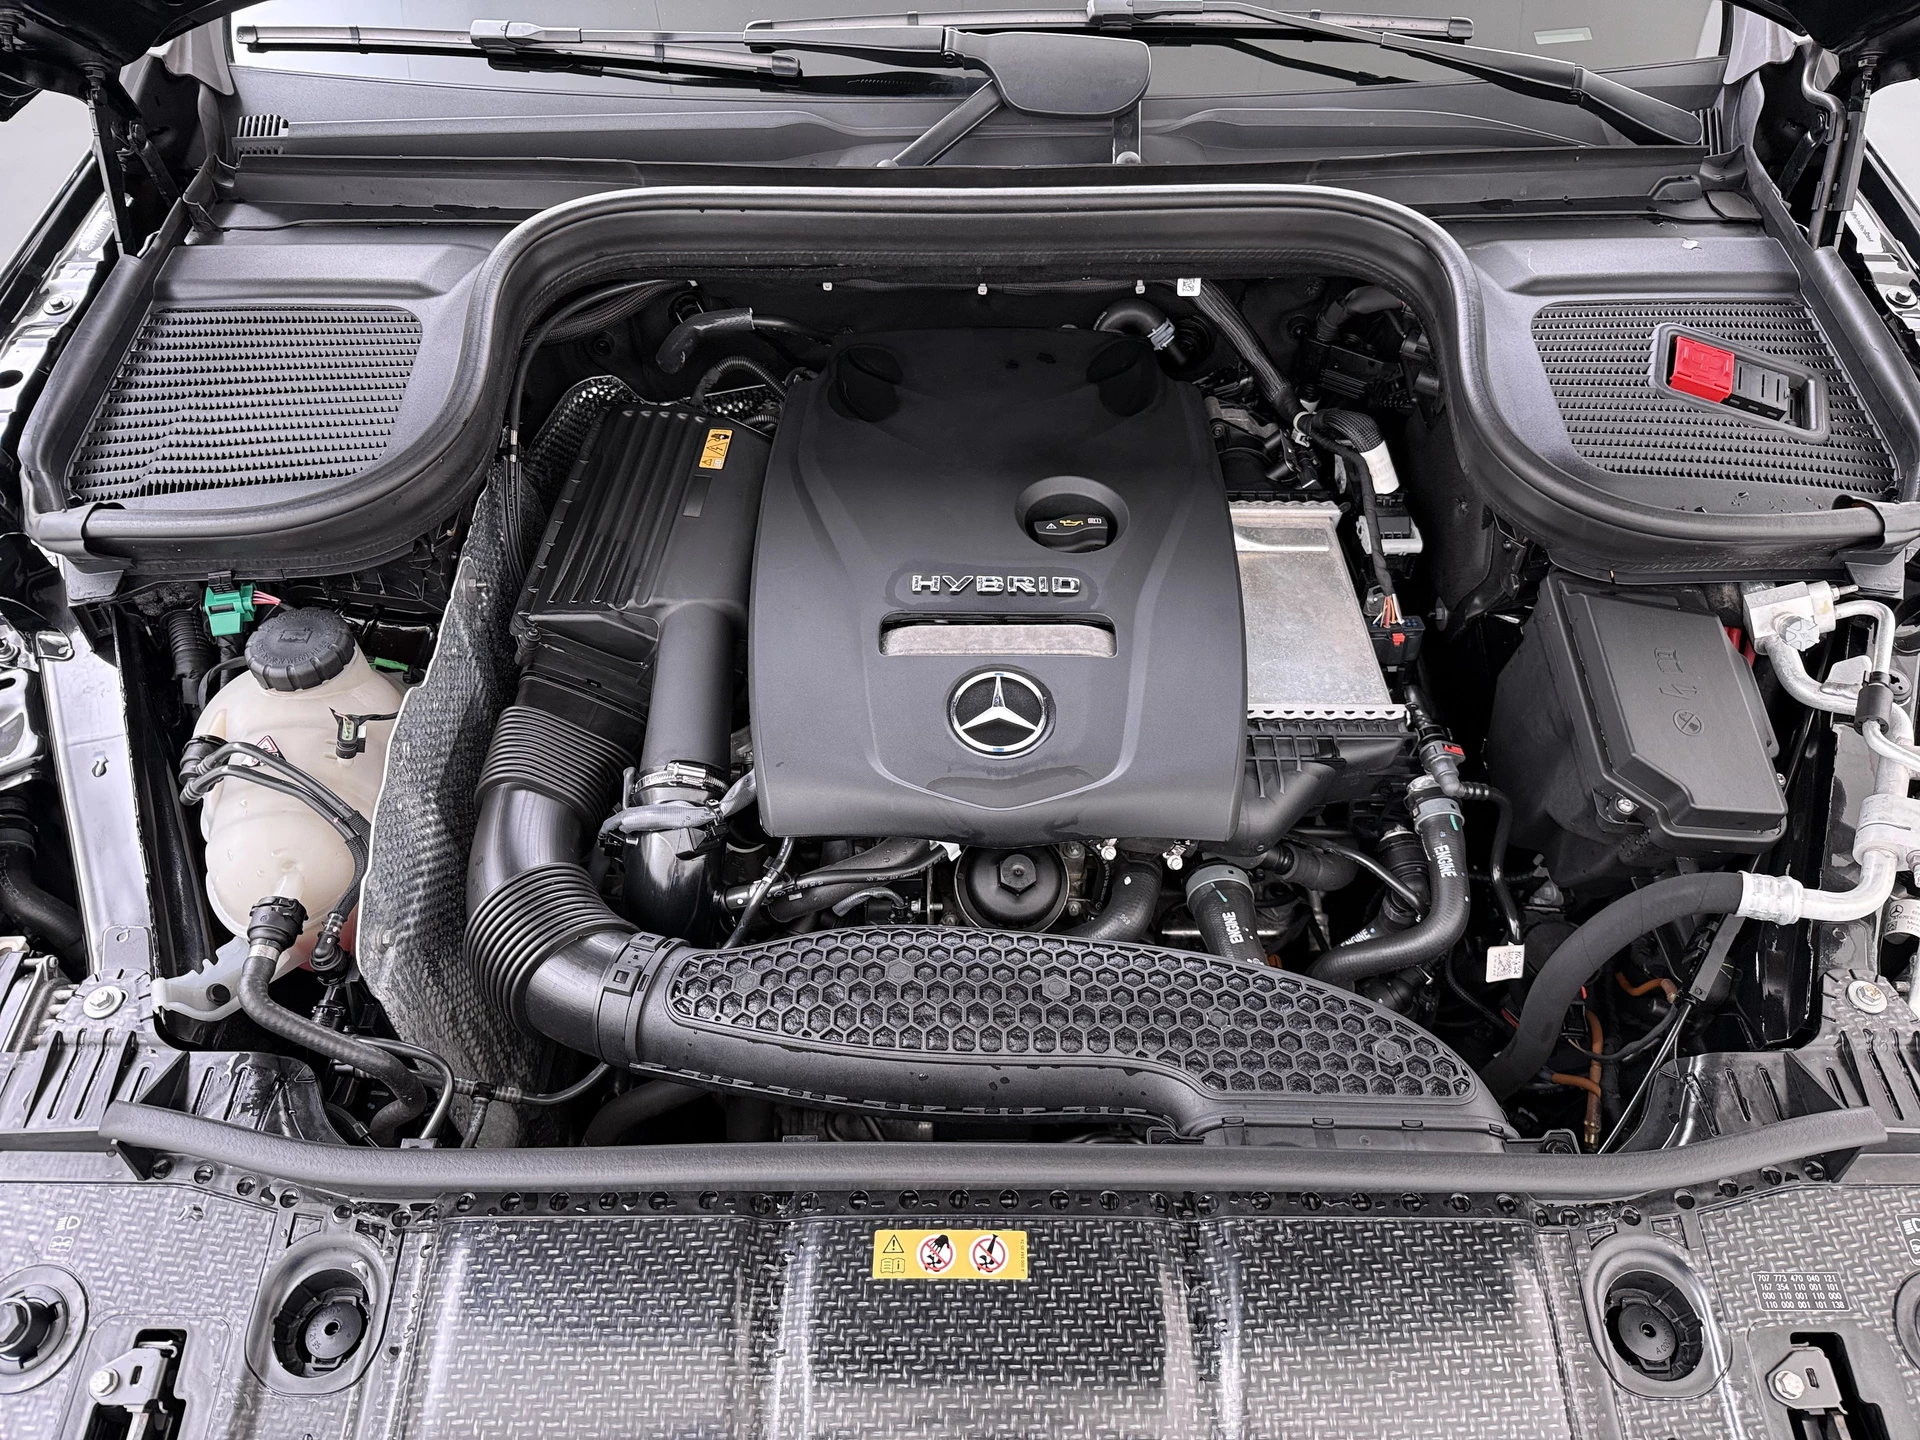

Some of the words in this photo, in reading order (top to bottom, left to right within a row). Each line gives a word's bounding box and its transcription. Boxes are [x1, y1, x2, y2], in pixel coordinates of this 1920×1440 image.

[911, 575, 1081, 594] HYBRID
[1434, 844, 1458, 879] ENGINE
[1222, 911, 1245, 945] ENGINE
[1757, 1274, 1770, 1283] 707
[1773, 1274, 1787, 1283] 773
[1790, 1274, 1803, 1283] 470
[1806, 1274, 1820, 1283] 040
[1823, 1274, 1837, 1283] 121
[1760, 1283, 1772, 1291] 167
[1776, 1283, 1789, 1291] 354
[1793, 1283, 1806, 1291] 110
[1808, 1283, 1822, 1291] 001
[1826, 1283, 1839, 1291] 101
[1762, 1292, 1775, 1300] 000
[1779, 1292, 1792, 1300] 110
[1795, 1292, 1808, 1300] 001
[1812, 1292, 1825, 1300] 110
[1828, 1292, 1842, 1300] 000
[1765, 1301, 1778, 1309] 110
[1781, 1301, 1795, 1309] 000
[1797, 1301, 1811, 1309] 001
[1815, 1301, 1828, 1309] 101
[1831, 1301, 1845, 1309] 138
